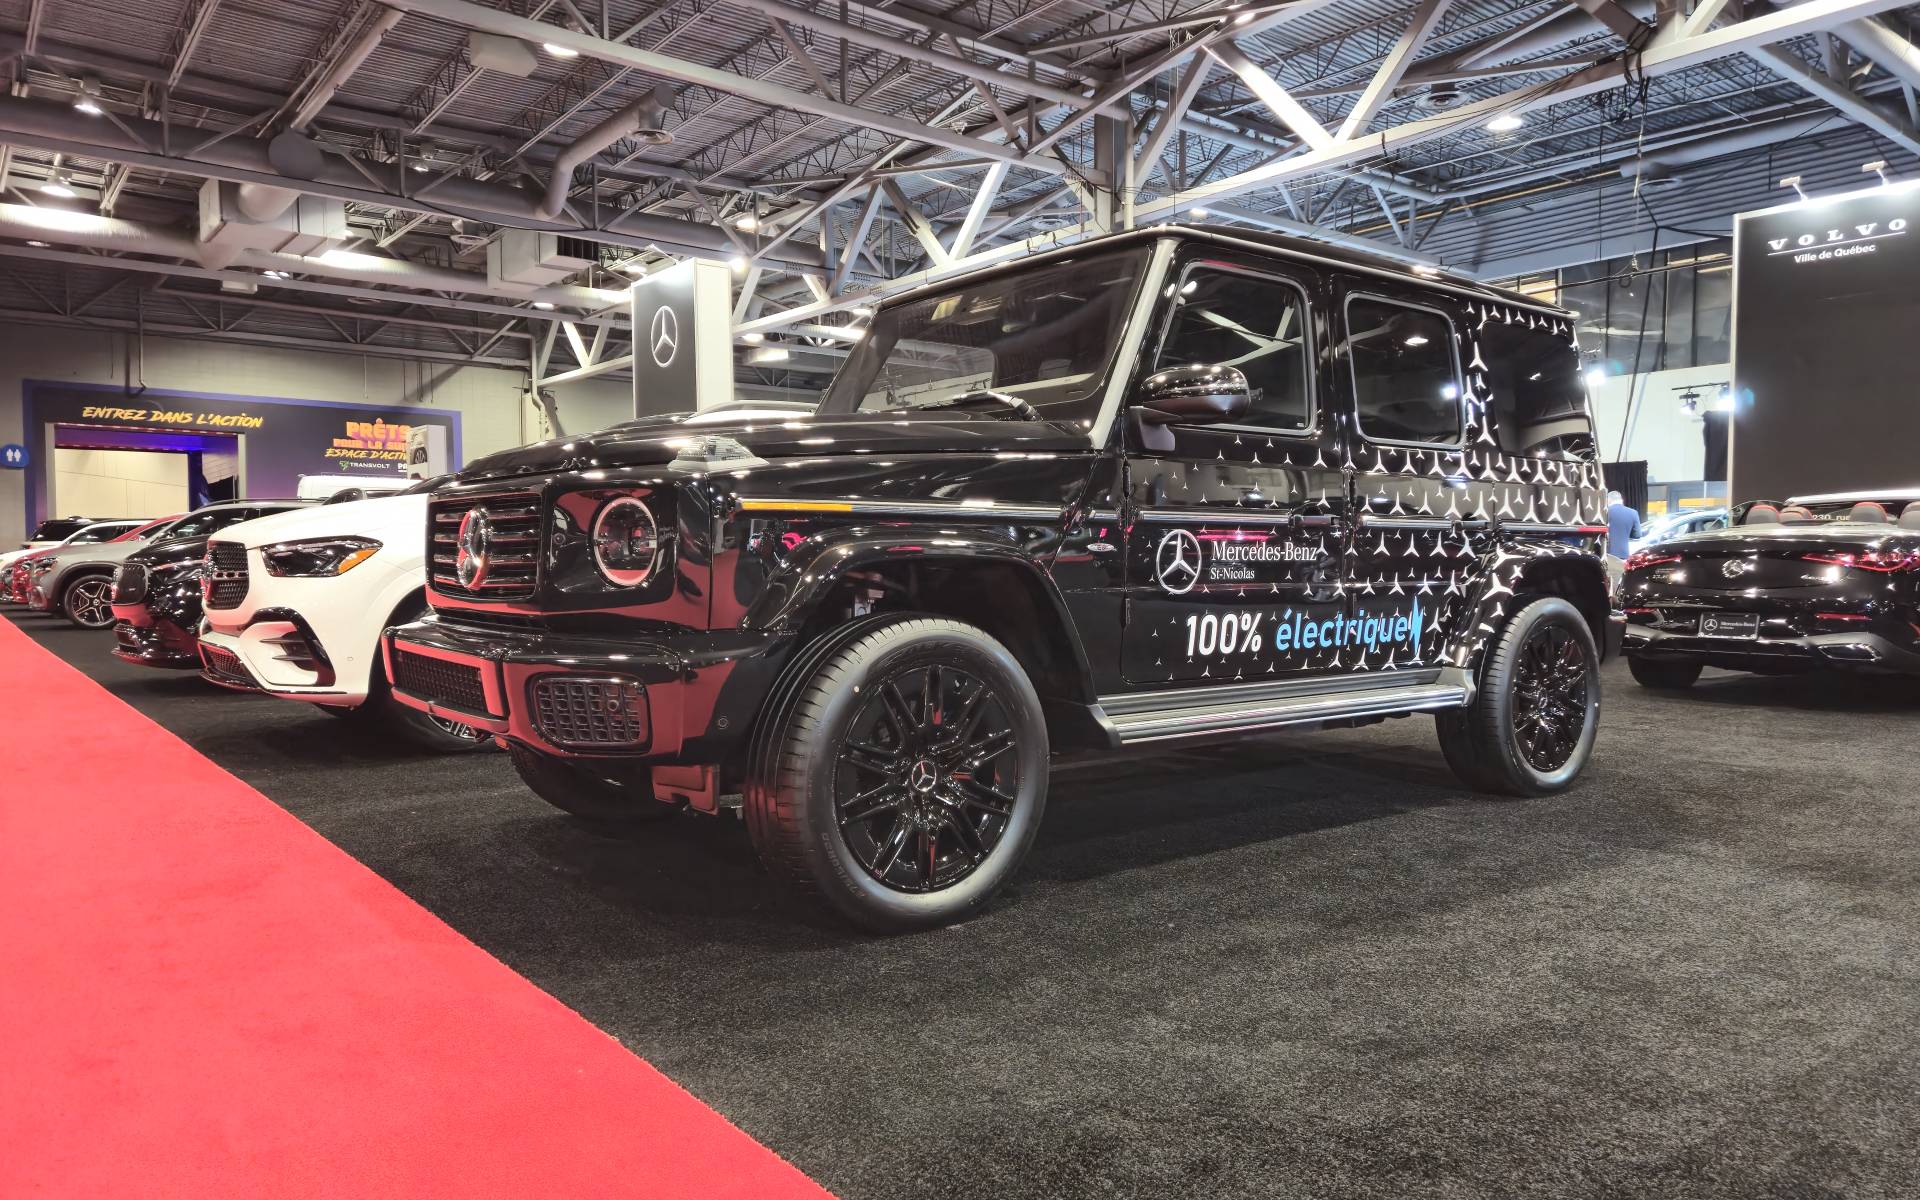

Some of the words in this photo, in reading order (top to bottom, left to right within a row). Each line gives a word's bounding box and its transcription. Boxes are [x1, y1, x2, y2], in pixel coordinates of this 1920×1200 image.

[1767, 218, 1907, 250] VOLVO
[1794, 253, 1817, 264] Ville
[1818, 250, 1832, 260] de
[1834, 244, 1876, 258] Québec
[82, 406, 147, 421] ENTREZ
[150, 410, 193, 424] DANS
[325, 448, 369, 459] ESPACE
[1211, 540, 1318, 561] Mercedes-Benz
[1210, 567, 1255, 580] St-Nicolas
[1186, 611, 1263, 656] 100%
[1276, 608, 1408, 652] électrique
